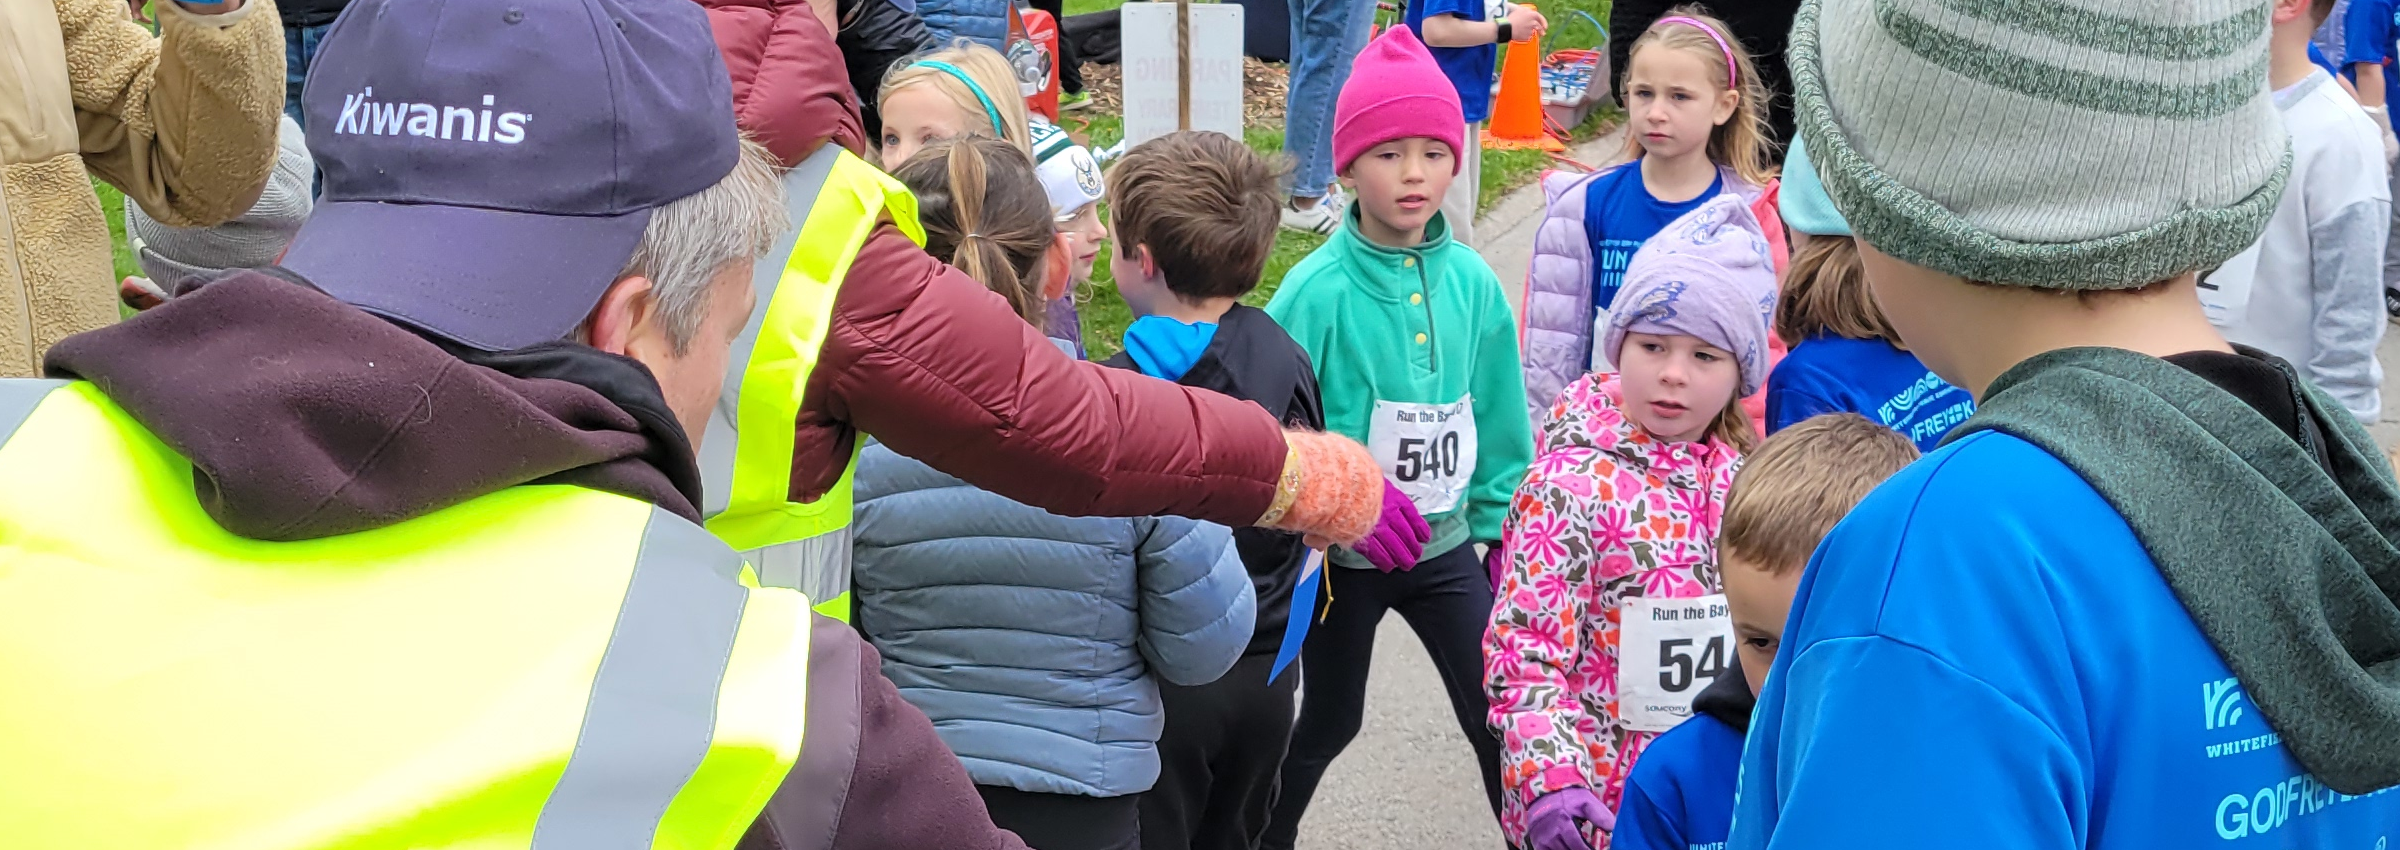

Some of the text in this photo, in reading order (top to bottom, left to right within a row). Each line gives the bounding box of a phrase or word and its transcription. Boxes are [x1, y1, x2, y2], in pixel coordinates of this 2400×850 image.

[334, 86, 526, 144] Kiwanis
[1396, 410, 1417, 423] Run
[1420, 410, 1435, 423] the
[1395, 430, 1459, 482] 540
[1652, 607, 1679, 621] Run
[1683, 606, 1705, 620] the
